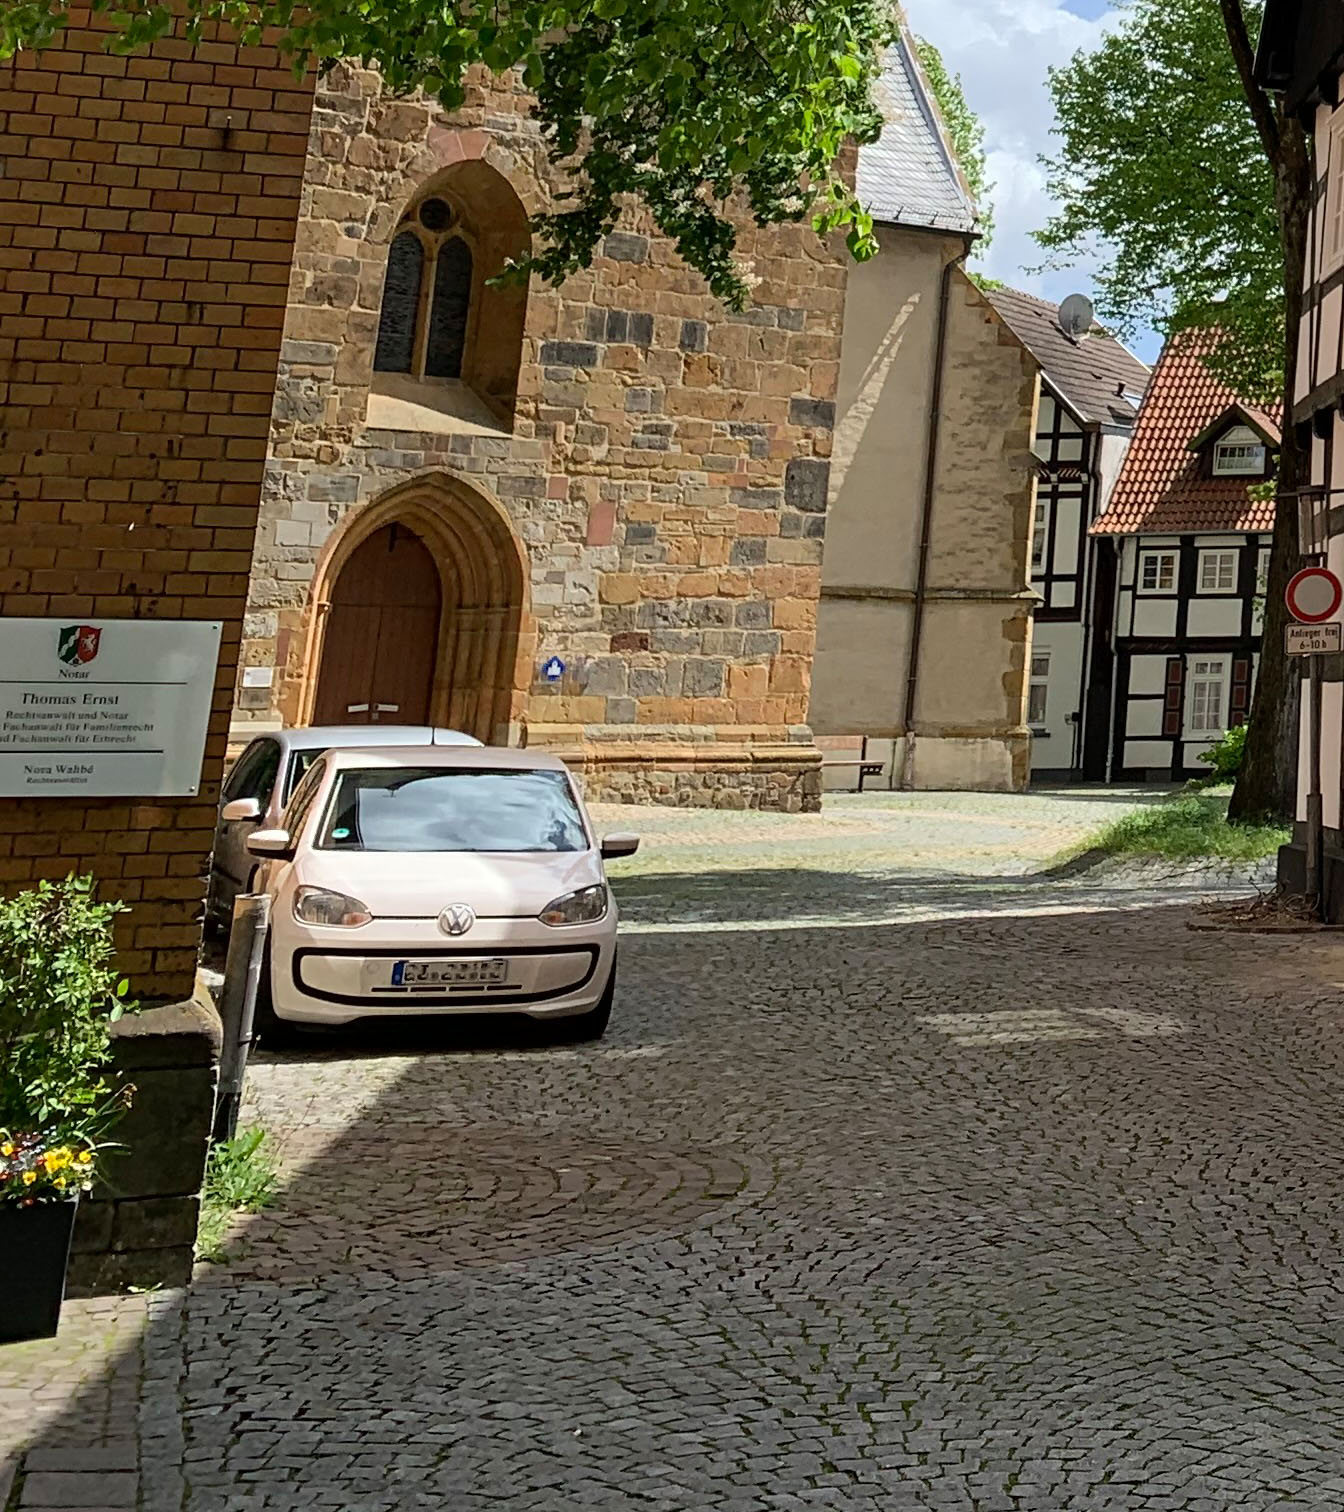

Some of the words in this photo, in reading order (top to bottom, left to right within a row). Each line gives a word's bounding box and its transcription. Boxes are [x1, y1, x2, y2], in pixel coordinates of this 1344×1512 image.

[58, 669, 90, 679] Notar
[22, 692, 77, 705] Thomas
[82, 693, 119, 705] Ernst
[6, 711, 75, 720] Rechtsanwalt
[78, 711, 97, 720] und
[100, 712, 129, 720] Notar
[3, 723, 62, 731] Fachanwalt
[65, 723, 80, 731] für
[83, 723, 154, 731] Familienrecht
[12, 734, 71, 743] Fachanwalt
[75, 734, 90, 743] für
[92, 735, 136, 743] Erbrecht
[24, 765, 52, 774] Nora
